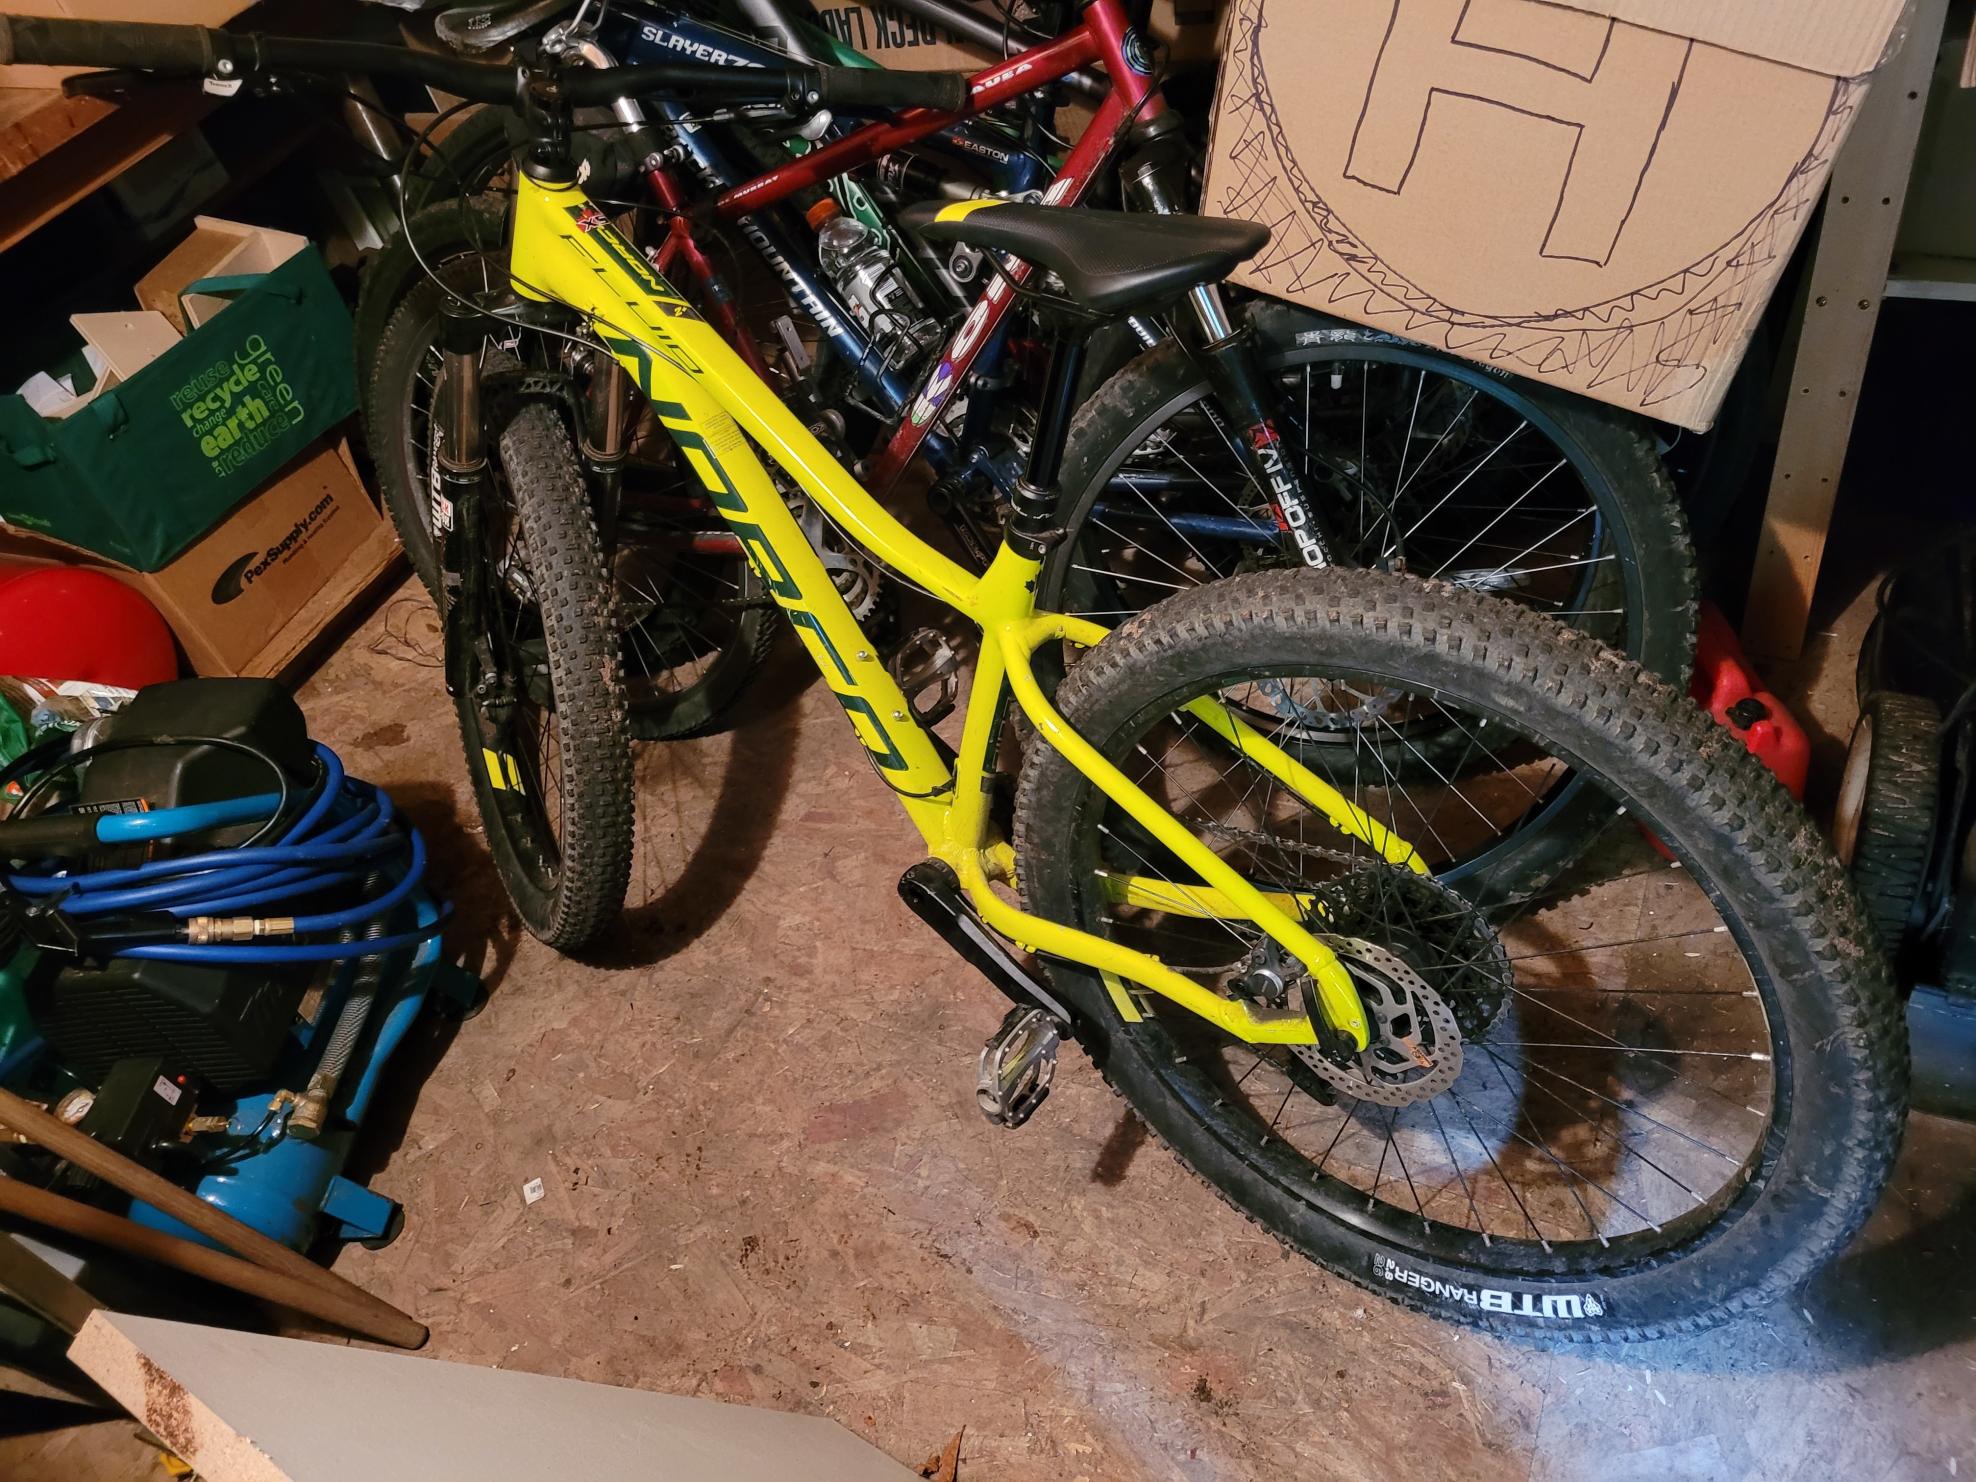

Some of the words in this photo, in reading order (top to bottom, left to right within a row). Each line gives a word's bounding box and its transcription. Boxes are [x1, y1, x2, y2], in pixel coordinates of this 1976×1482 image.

[963, 140, 1009, 162] EASTON
[733, 175, 779, 199] MURRAY
[560, 234, 705, 374] FLUID
[170, 360, 231, 410] reuse
[181, 363, 261, 428] recycle
[234, 334, 305, 425] green
[192, 408, 228, 438] change
[200, 395, 270, 458] earth
[219, 411, 290, 474] reduce
[243, 493, 334, 585] PexSupply.com
[603, 335, 909, 771] NORCO
[1394, 1266, 1478, 1305] RANGER
[1479, 1288, 1586, 1319] WTB
